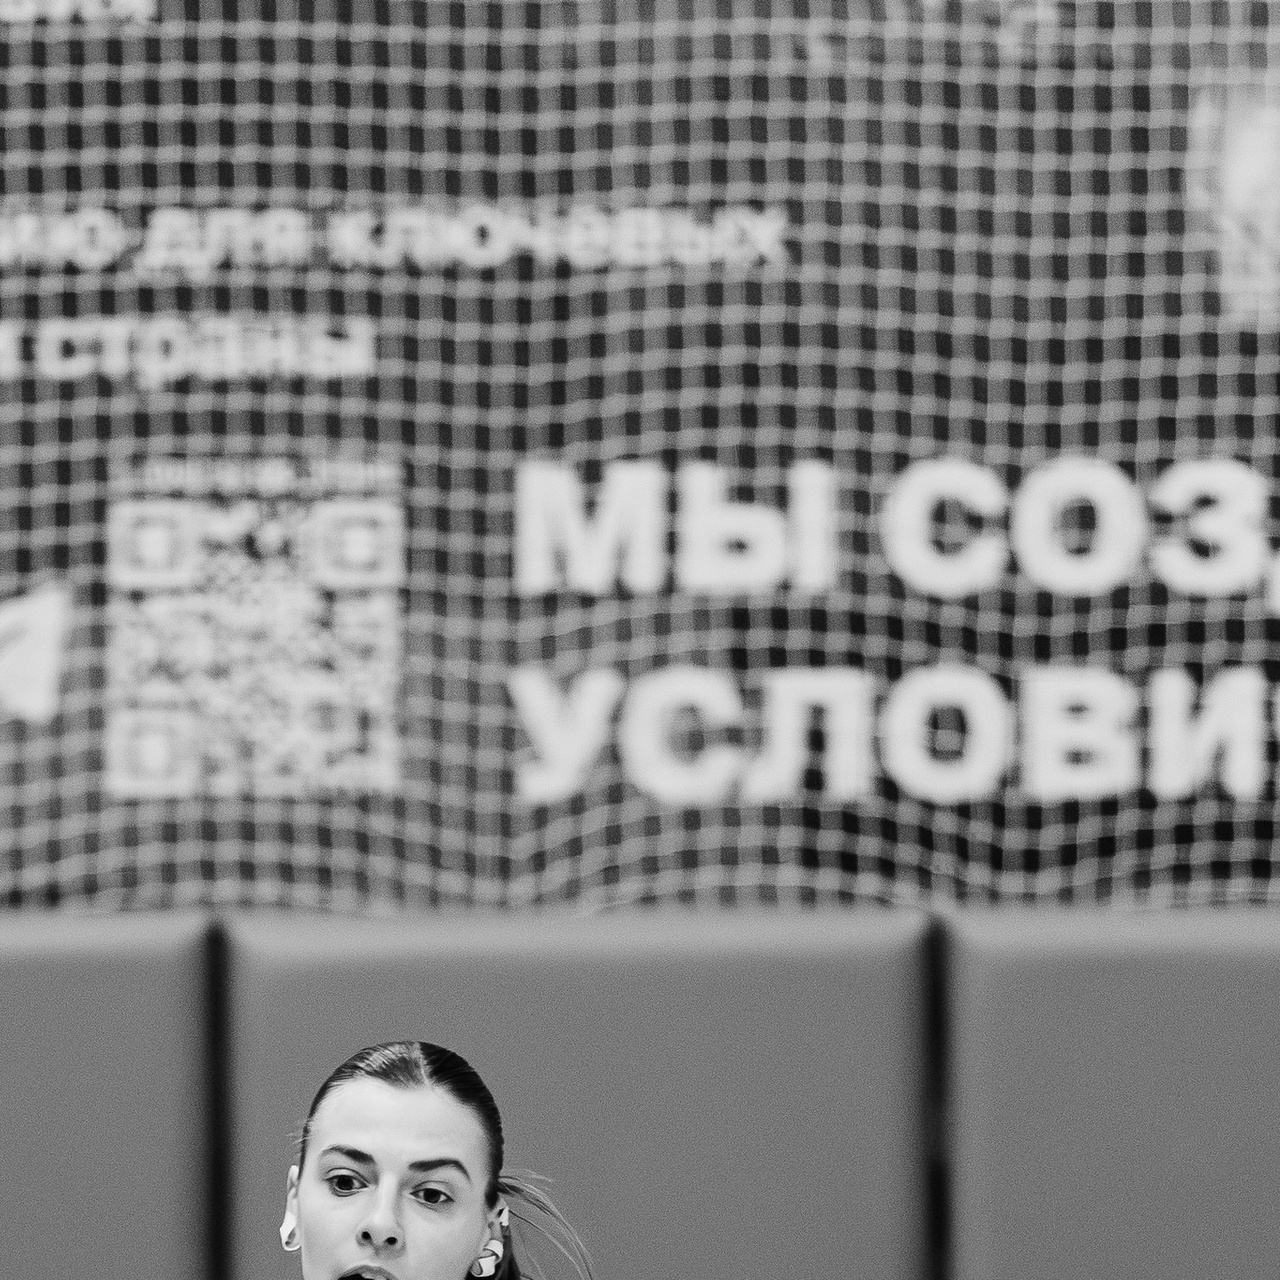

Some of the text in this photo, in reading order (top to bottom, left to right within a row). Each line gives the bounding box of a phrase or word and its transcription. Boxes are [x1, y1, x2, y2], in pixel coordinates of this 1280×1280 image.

[131, 205, 316, 281] для
[324, 203, 786, 272] ключевых
[34, 316, 376, 392] страны
[518, 454, 1280, 614] МЫ СОЗ
